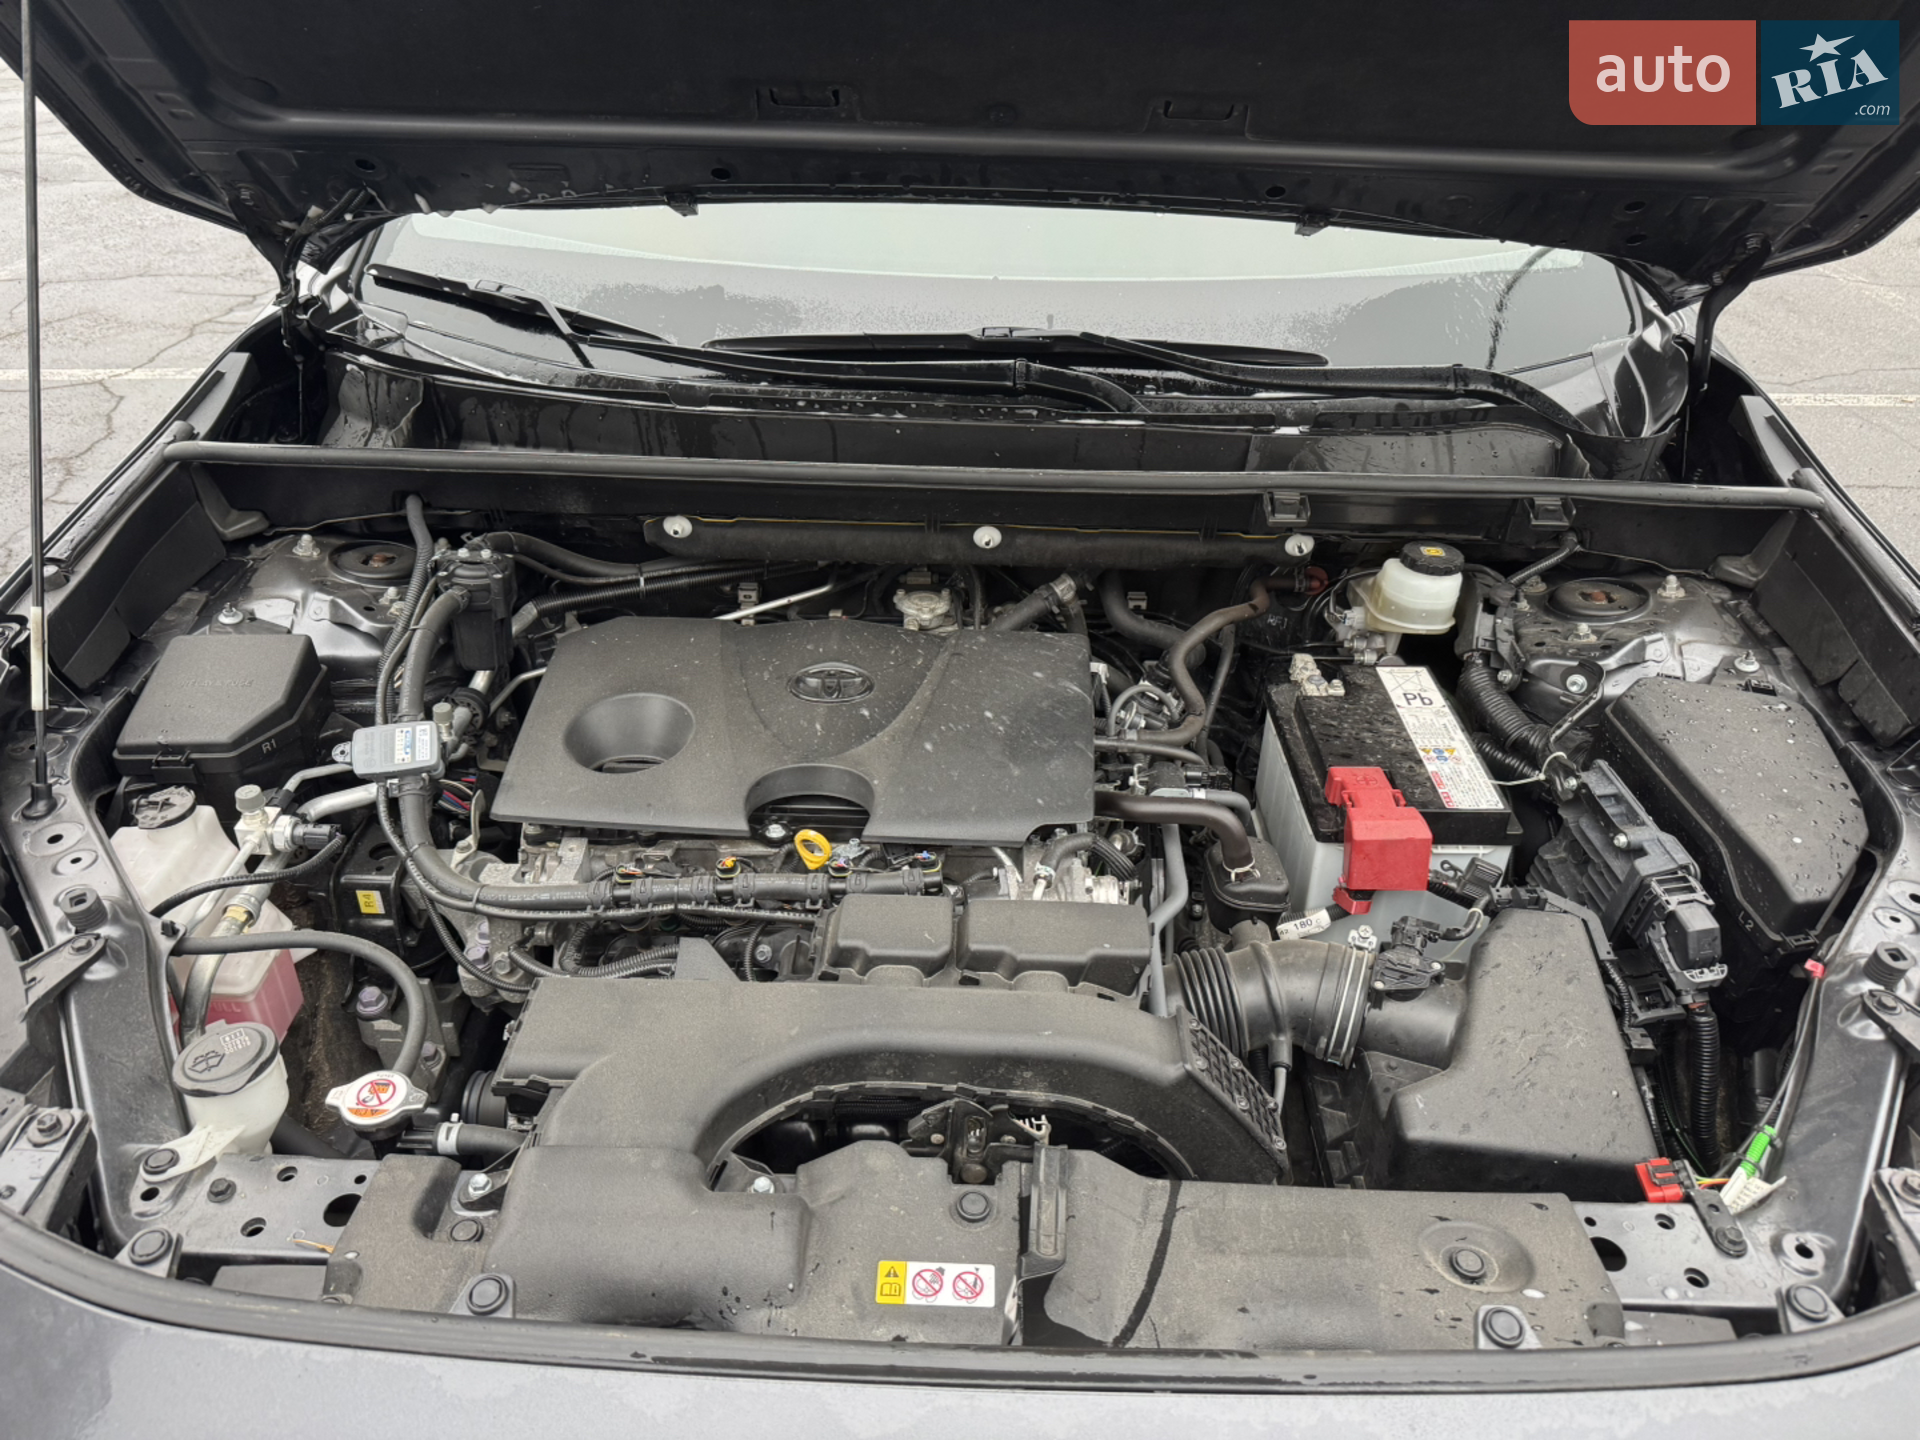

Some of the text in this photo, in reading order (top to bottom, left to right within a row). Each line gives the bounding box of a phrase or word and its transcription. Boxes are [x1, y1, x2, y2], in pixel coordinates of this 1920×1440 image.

[1402, 692, 1434, 706] Pb
[261, 738, 277, 754] R1
[1293, 918, 1313, 931] 180
[1738, 910, 1754, 931] L2
